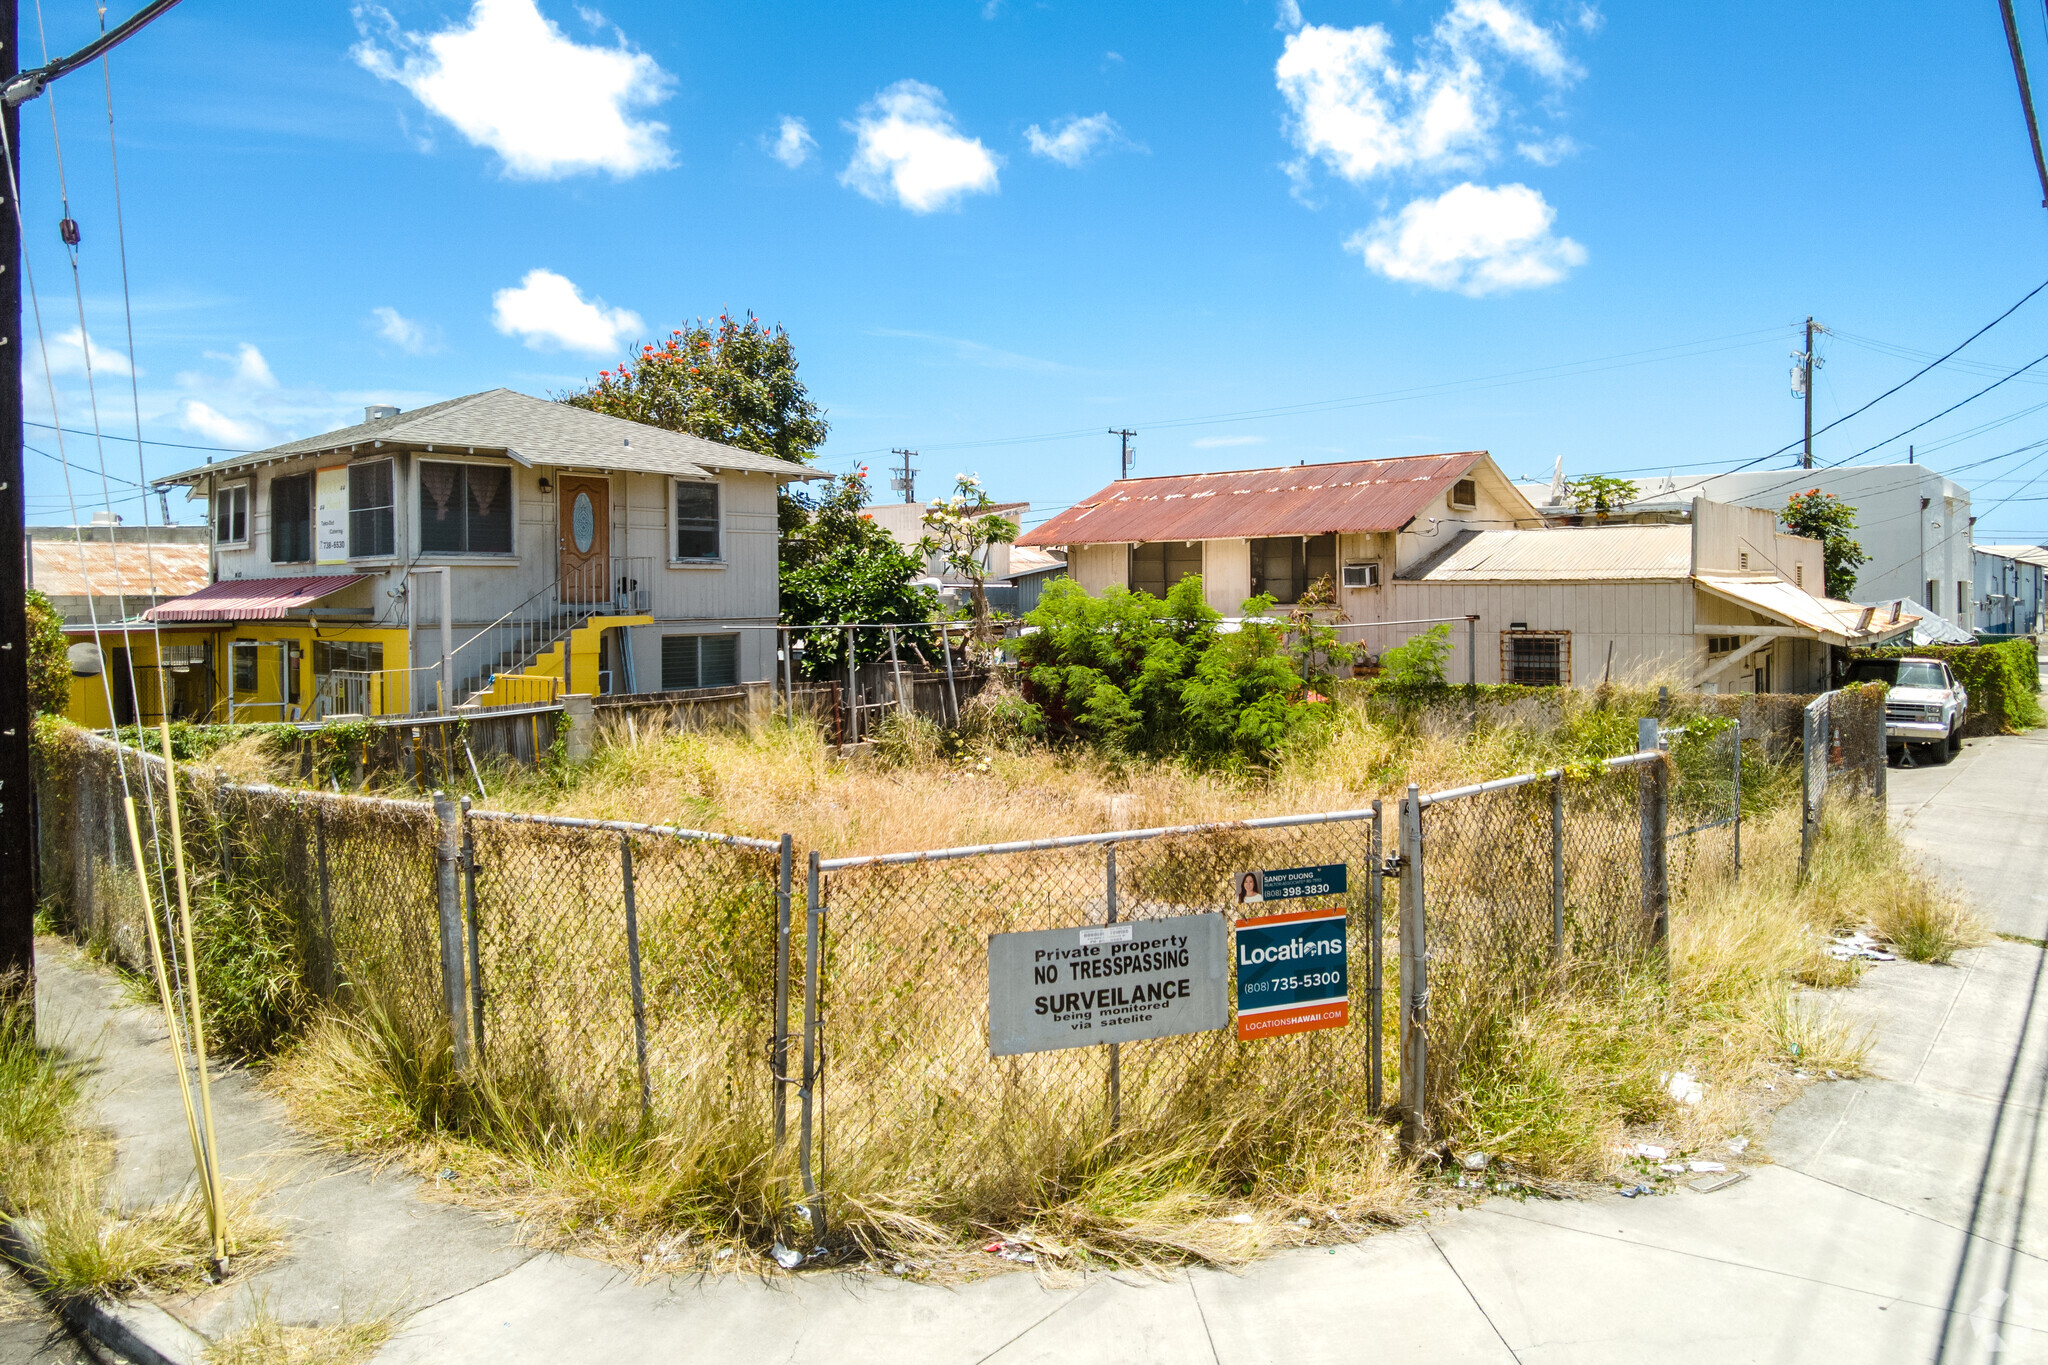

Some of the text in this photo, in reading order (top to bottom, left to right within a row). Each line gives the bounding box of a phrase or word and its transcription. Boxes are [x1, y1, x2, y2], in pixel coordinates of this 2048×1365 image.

[1264, 875, 1287, 883] SANDY
[1288, 872, 1314, 881] DUONG
[1264, 883, 1330, 899] (808) 398-3830
[1035, 945, 1100, 962] Private
[1111, 934, 1188, 956] property
[1240, 937, 1342, 966] Locations
[1034, 948, 1190, 985] NO TRESSPASSING
[1244, 971, 1340, 995] (808) 735-5300
[1034, 978, 1191, 1016] SURVEILANCE
[1053, 1000, 1170, 1022] being monitored
[1071, 1013, 1153, 1030] via satelite
[1245, 1010, 1342, 1031] LOCATIONSHAWAII.COM
